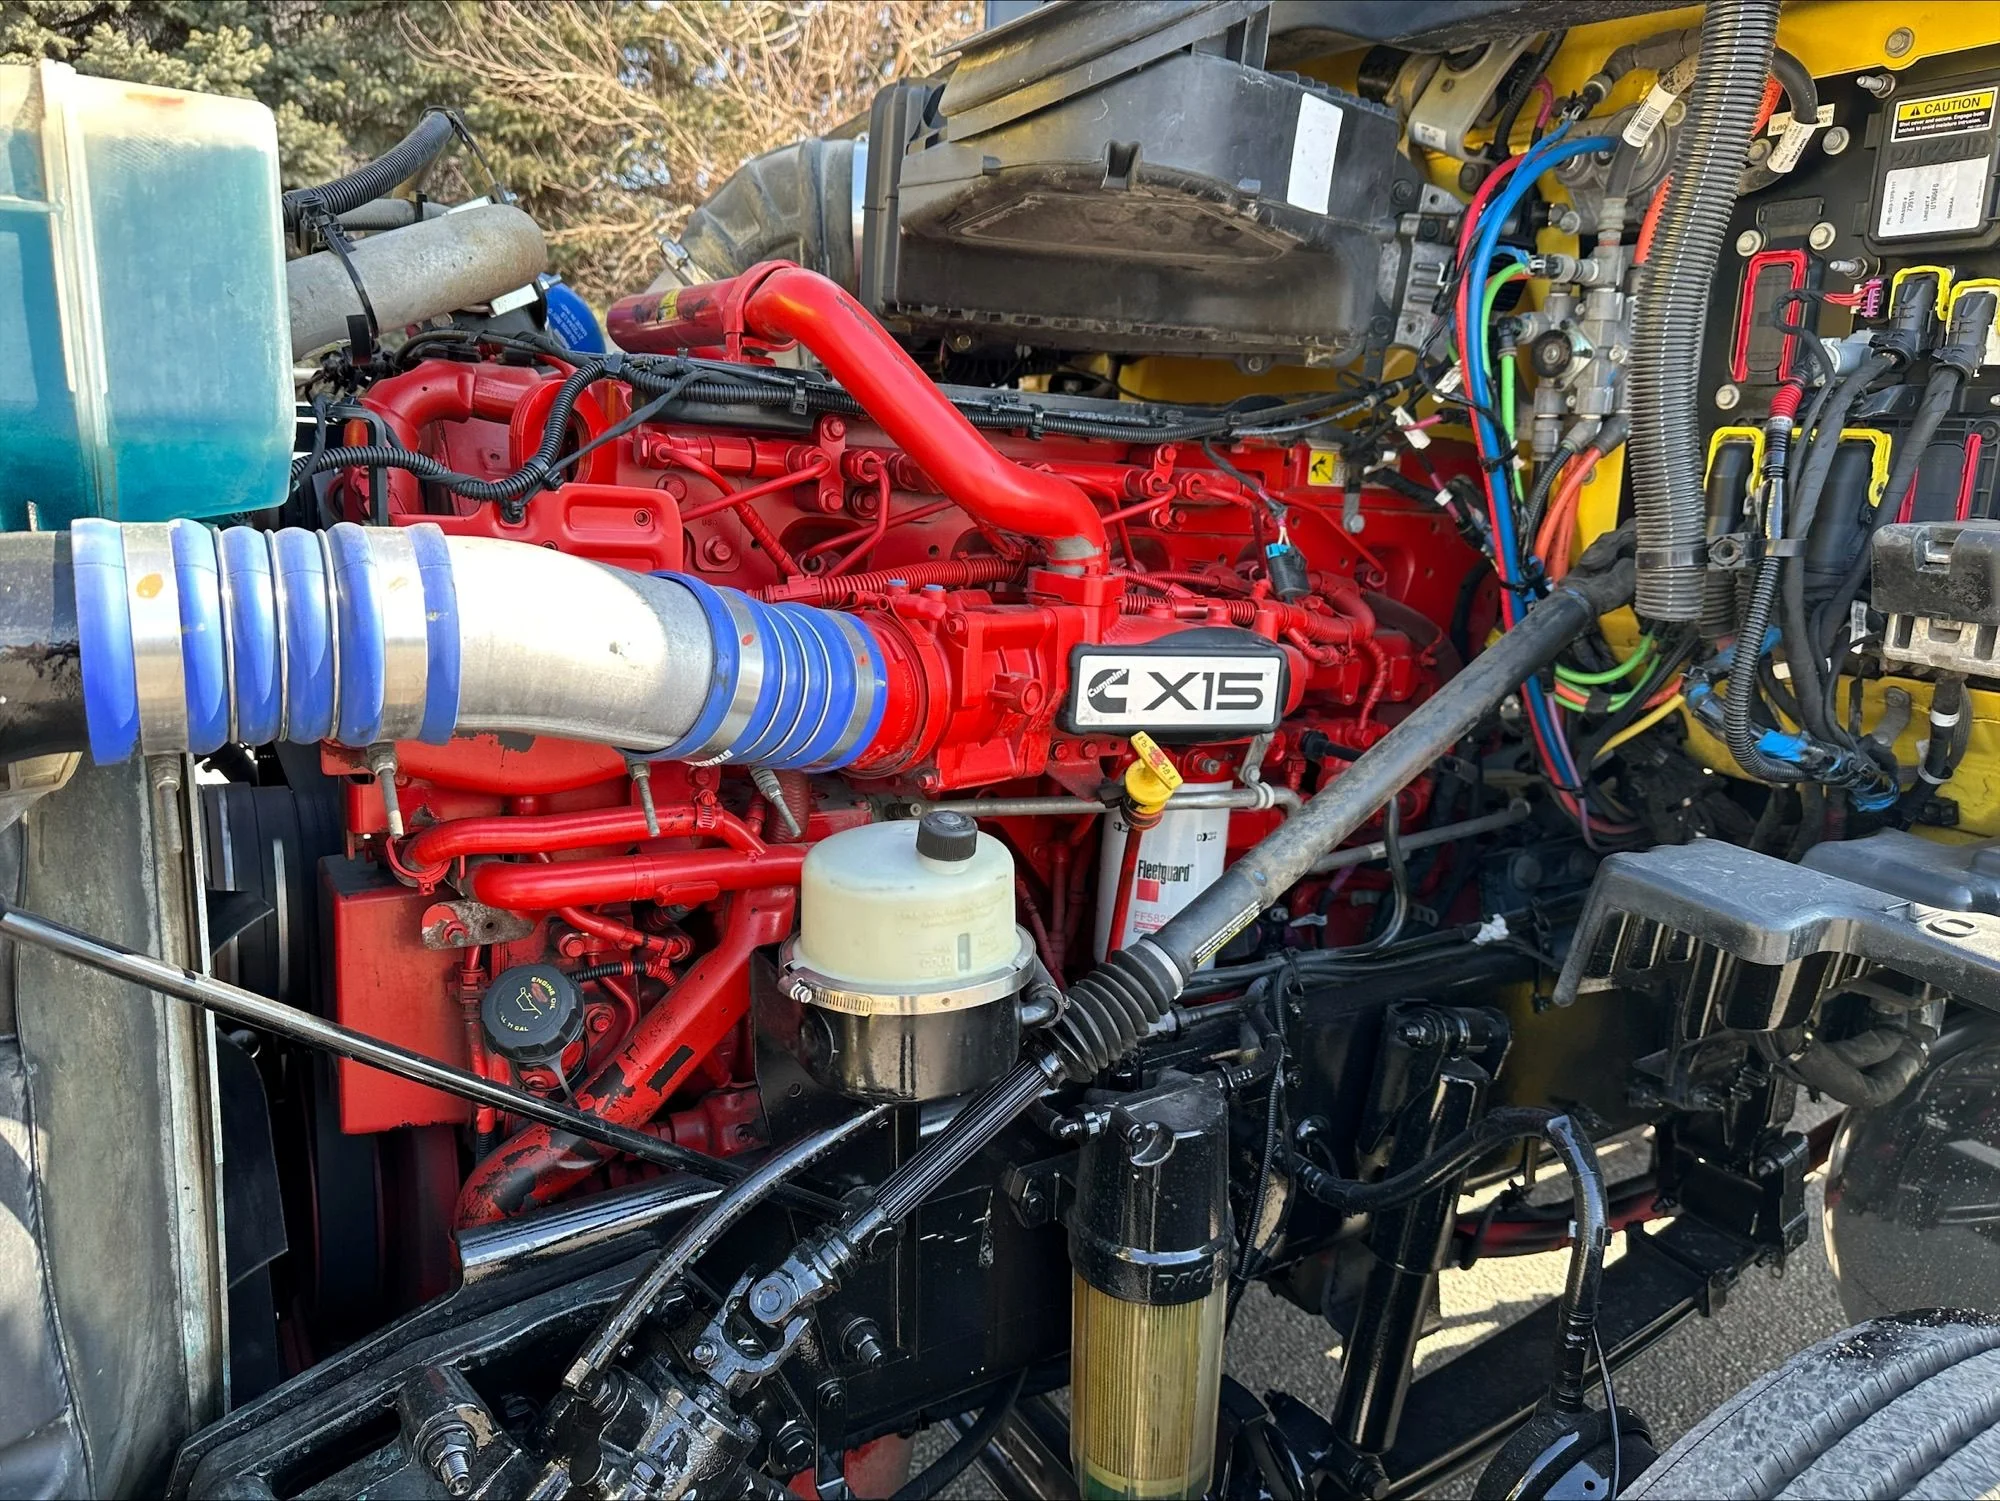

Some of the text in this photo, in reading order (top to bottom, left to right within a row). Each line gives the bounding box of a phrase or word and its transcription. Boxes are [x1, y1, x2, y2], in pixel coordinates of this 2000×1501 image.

[1924, 97, 1980, 114] CAUTION
[1953, 112, 1972, 121] Engage
[1936, 121, 1957, 129] moisture
[1087, 668, 1128, 698] Cummins
[1142, 671, 1264, 711] X15
[1137, 859, 1191, 885] Fleetguard
[531, 976, 557, 1010] ENGINE OIL
